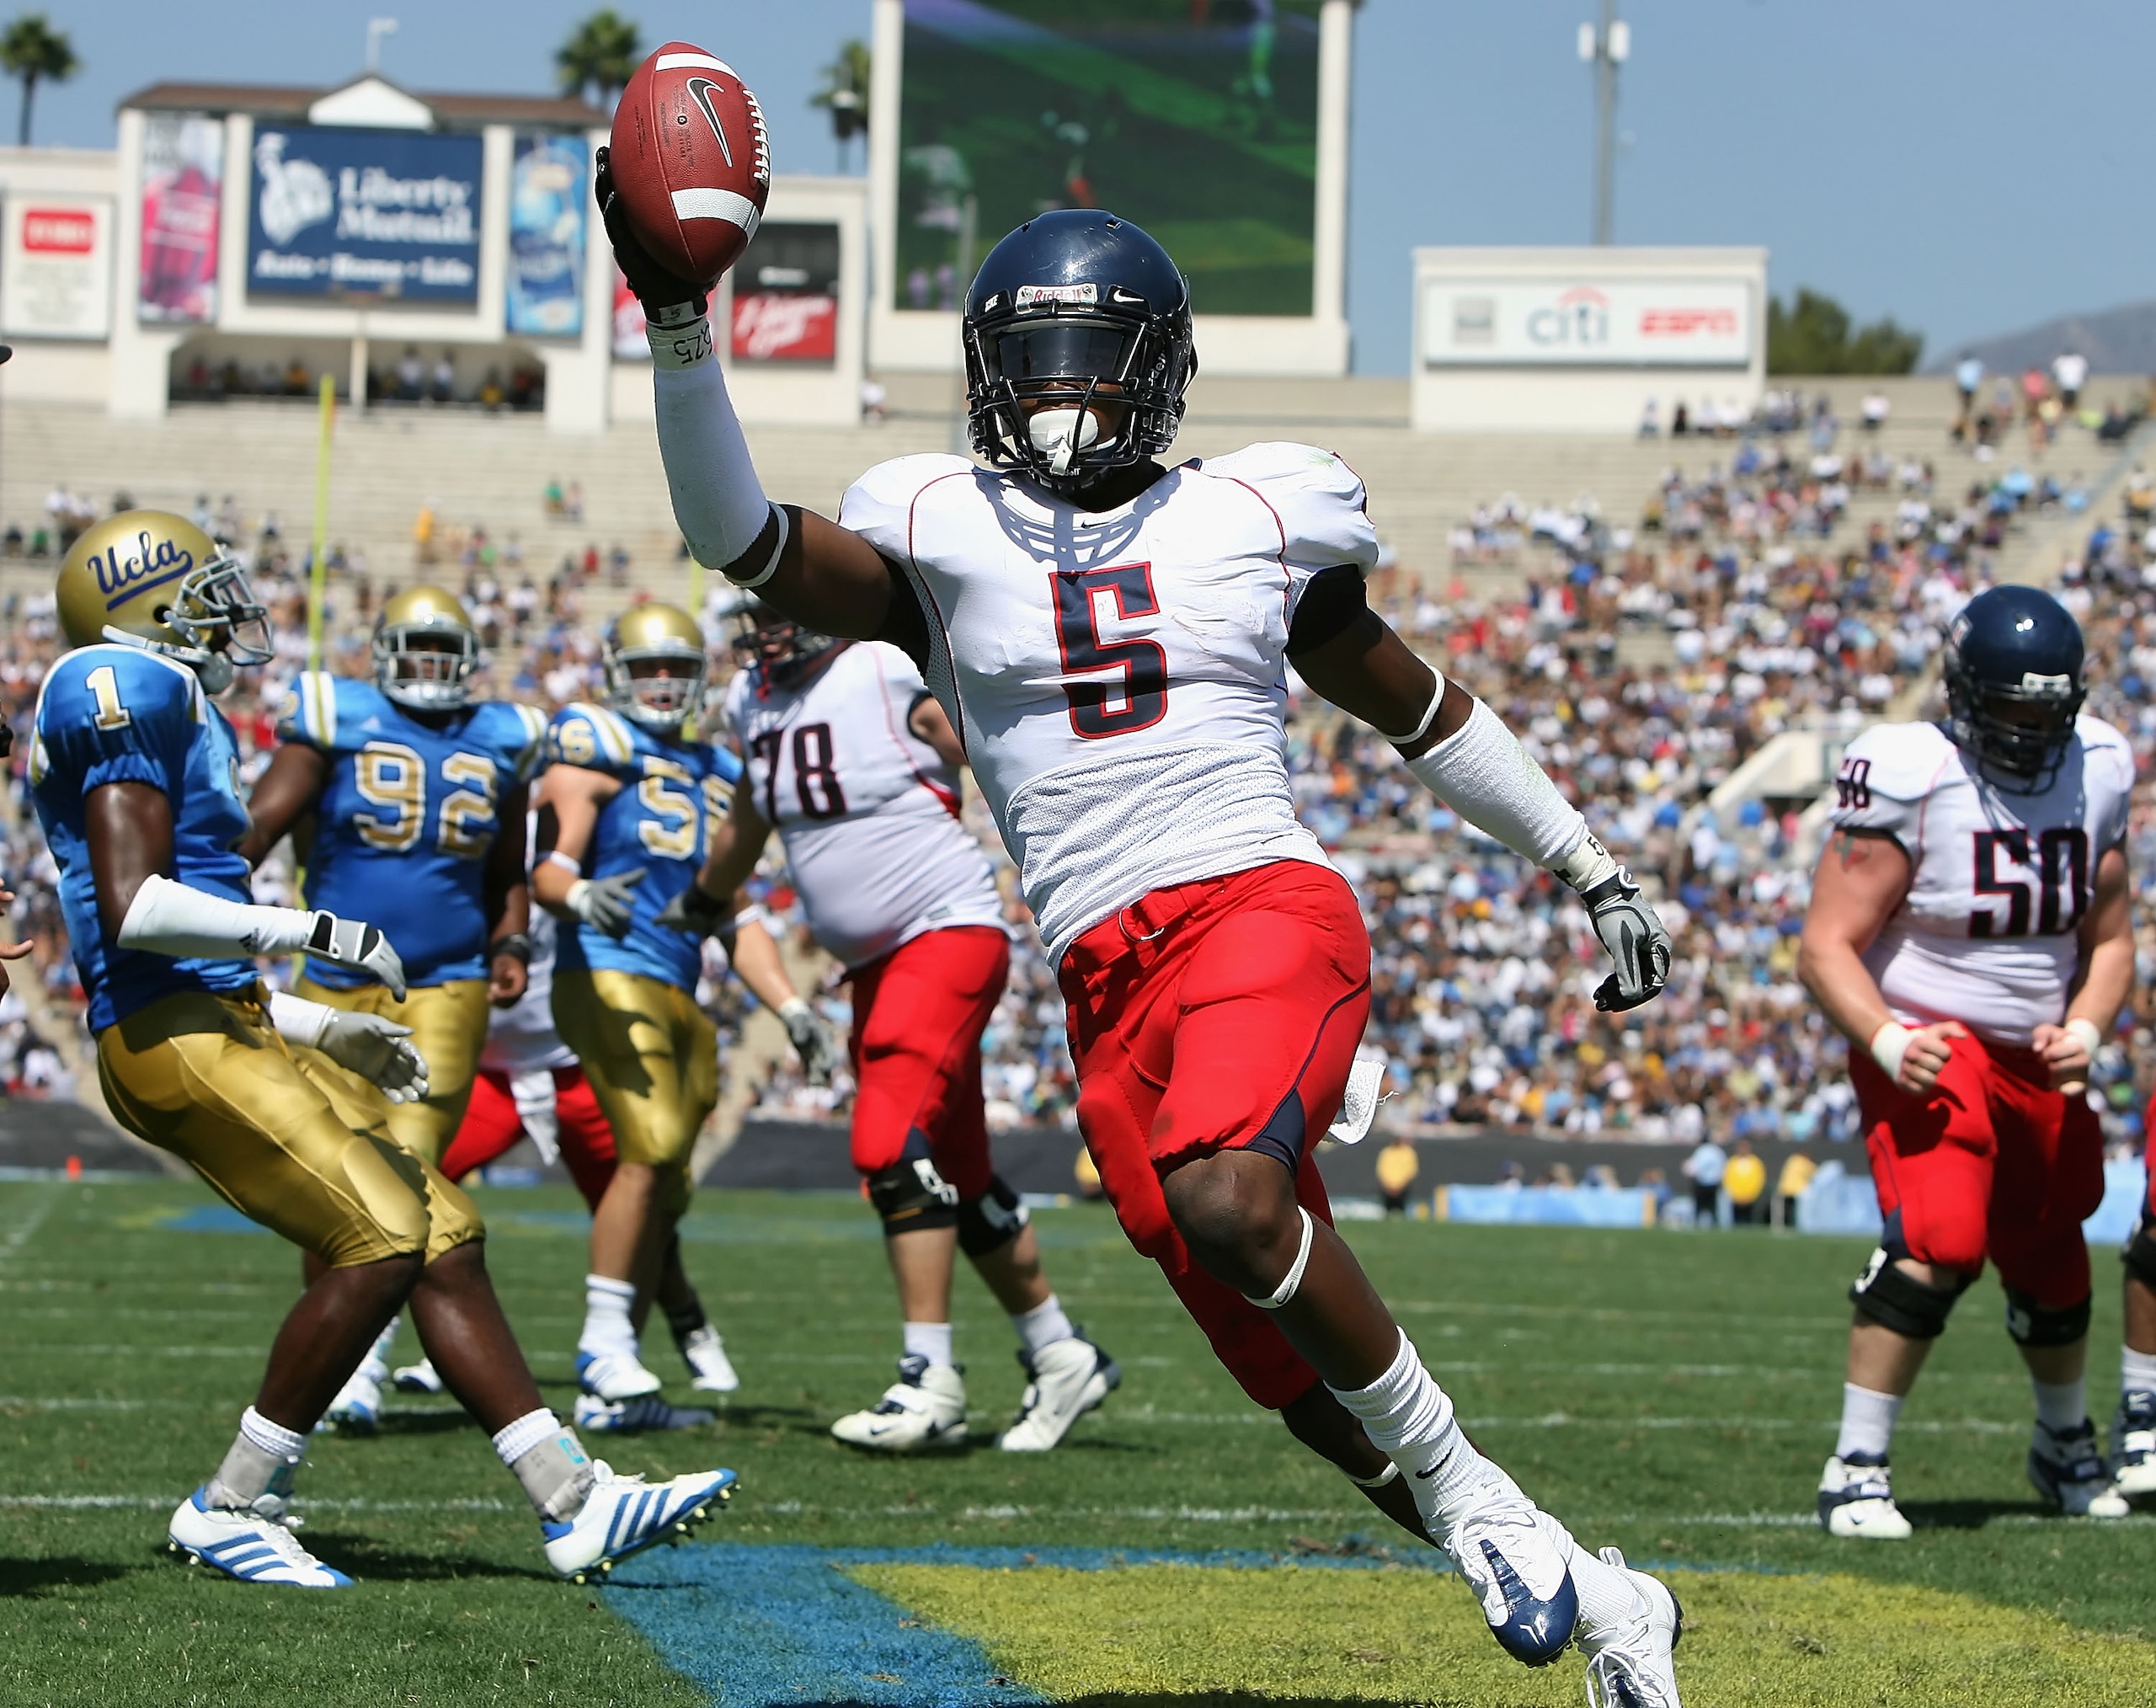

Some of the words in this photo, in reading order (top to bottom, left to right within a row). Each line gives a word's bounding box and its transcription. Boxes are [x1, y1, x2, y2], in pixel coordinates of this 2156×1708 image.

[339, 167, 472, 211] Liberty
[256, 250, 316, 280] Auto
[331, 254, 404, 283] Home
[421, 256, 474, 287] Life
[1527, 305, 1609, 345] citi
[1639, 307, 1739, 338] ESPN
[87, 531, 192, 601] Ucla
[1048, 561, 1168, 739] 5
[86, 665, 131, 731] 1
[354, 739, 499, 859] 92
[749, 720, 847, 825] 78
[1587, 835, 1604, 857] 5
[1967, 825, 2089, 939] 50
